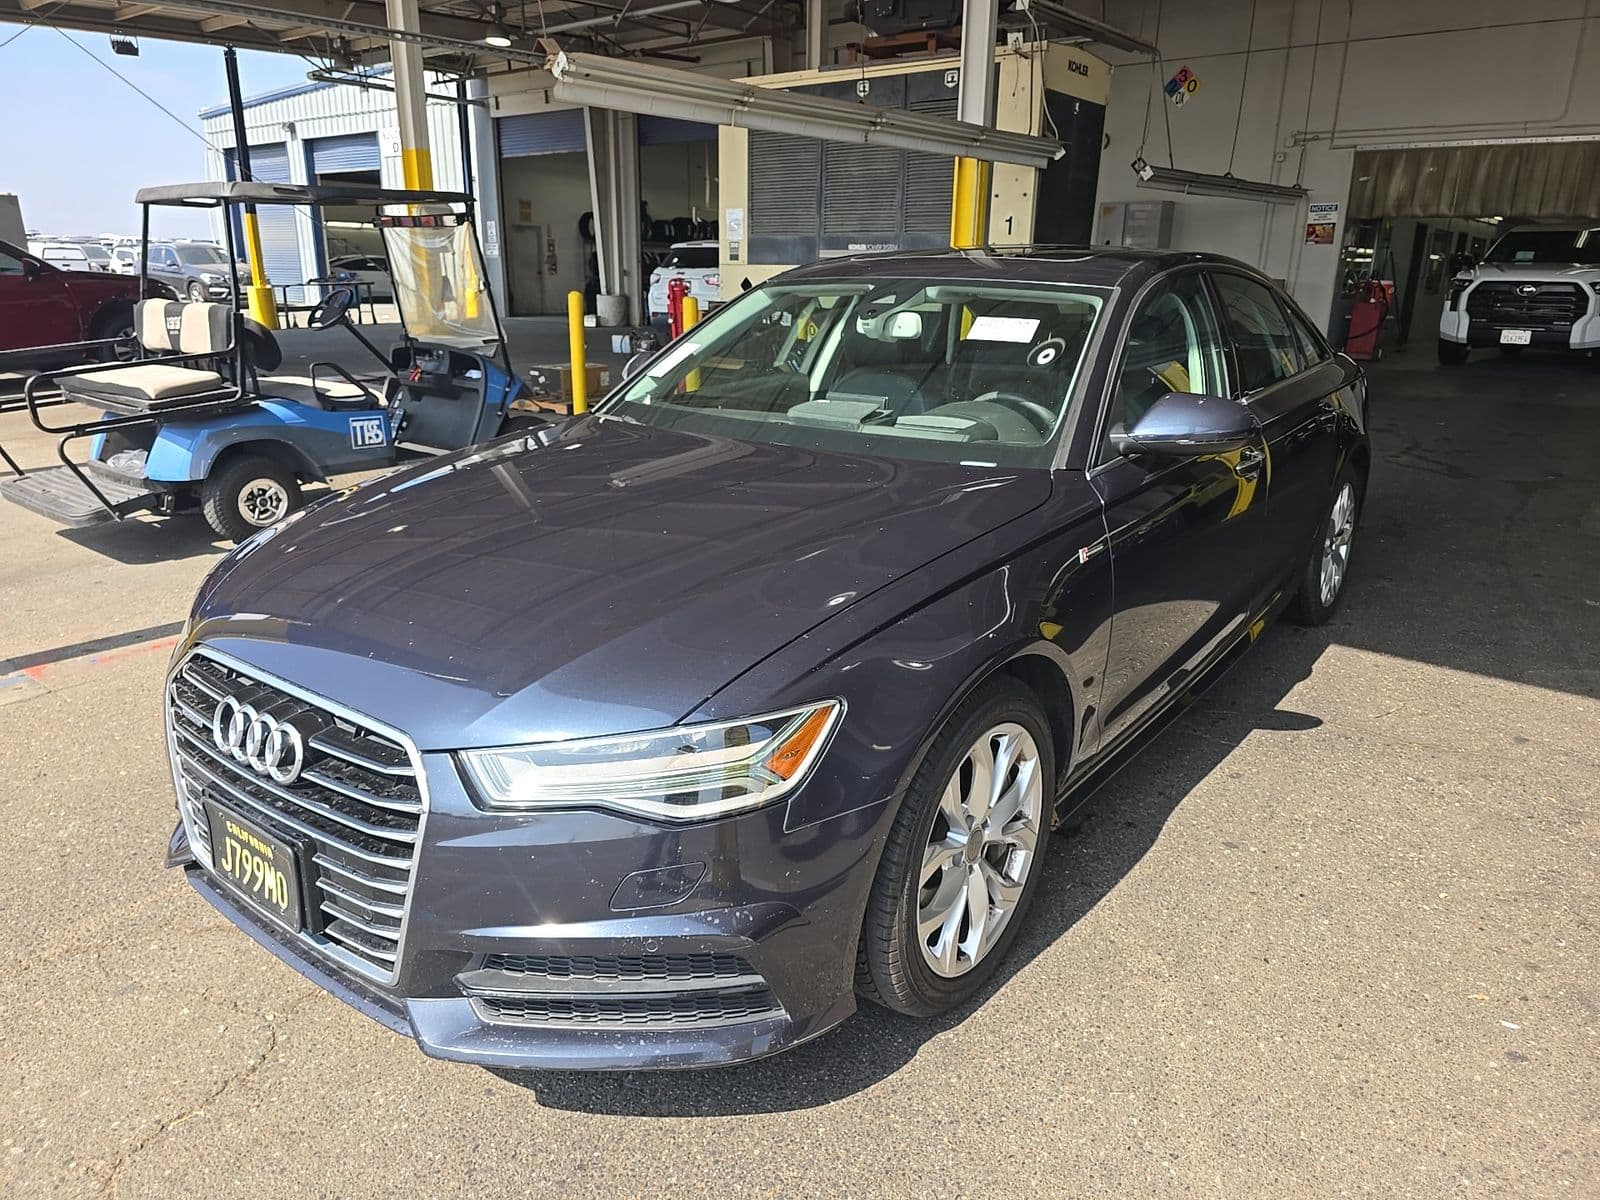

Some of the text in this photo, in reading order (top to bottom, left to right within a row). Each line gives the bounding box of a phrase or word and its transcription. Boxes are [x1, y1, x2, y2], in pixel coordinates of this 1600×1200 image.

[1067, 59, 1089, 77] KOHLER
[1179, 69, 1188, 82] 3
[1005, 215, 1013, 235] 1
[226, 820, 274, 860] CALIFORNIA
